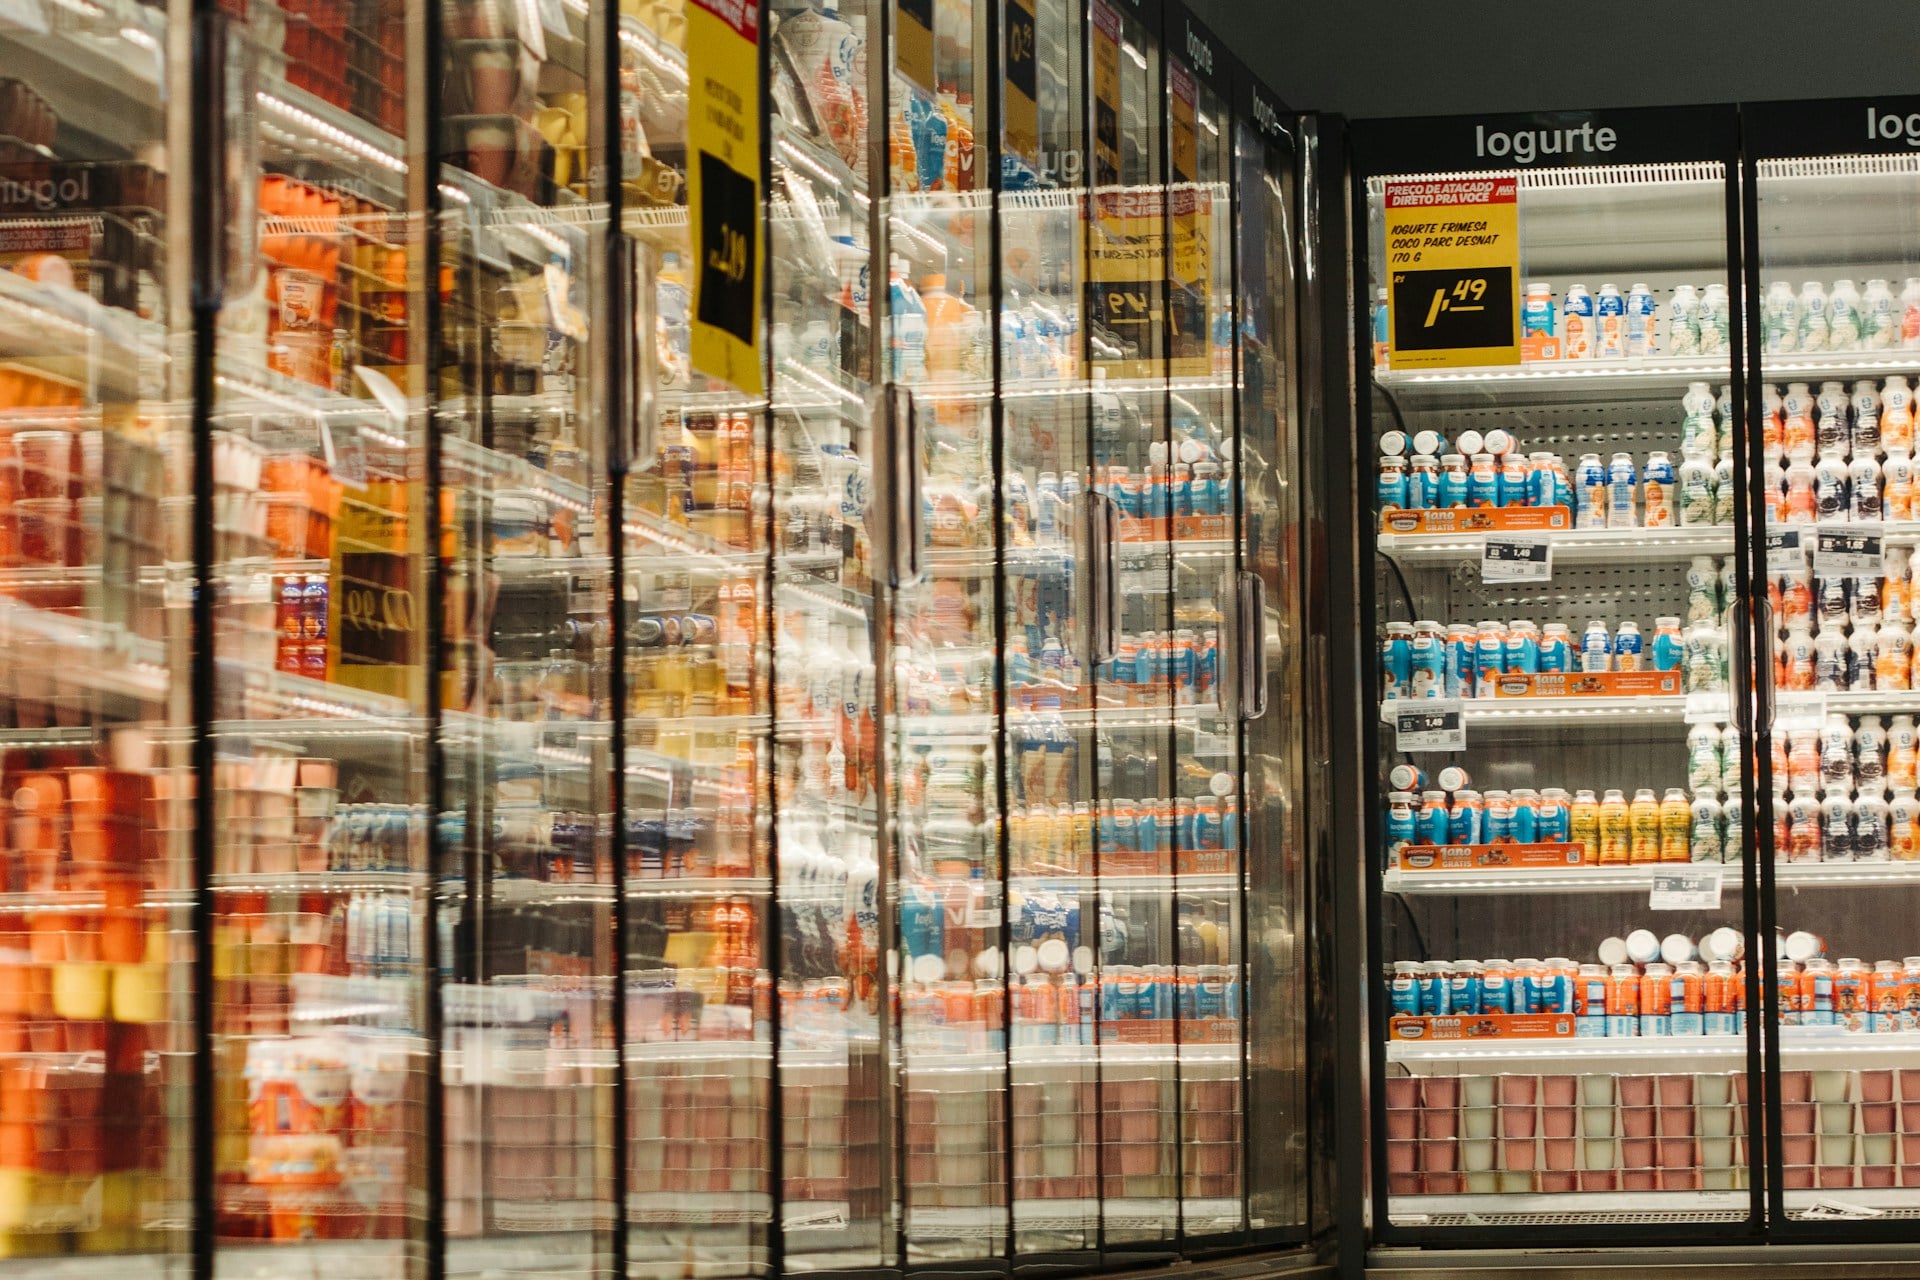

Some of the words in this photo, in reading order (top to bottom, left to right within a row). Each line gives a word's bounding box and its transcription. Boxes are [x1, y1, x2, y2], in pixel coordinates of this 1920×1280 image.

[1186, 19, 1213, 75] Iogurte
[1476, 121, 1617, 164] Iogurte
[1387, 185, 1424, 197] PREÇO
[1425, 184, 1441, 194] DE
[1441, 181, 1495, 193] ATACADO
[1392, 194, 1434, 206] DIRETO
[1435, 193, 1459, 204] PRA
[1391, 224, 1438, 236] IOGURTE
[1440, 221, 1488, 233] FRIMESA
[1392, 237, 1420, 249] COCO
[1423, 237, 1451, 248] PARC
[1455, 234, 1500, 246] DESNAT
[1392, 252, 1410, 263] 170
[1413, 252, 1422, 263] G
[1513, 548, 1531, 557] 1,49
[1425, 717, 1443, 728] 1,49
